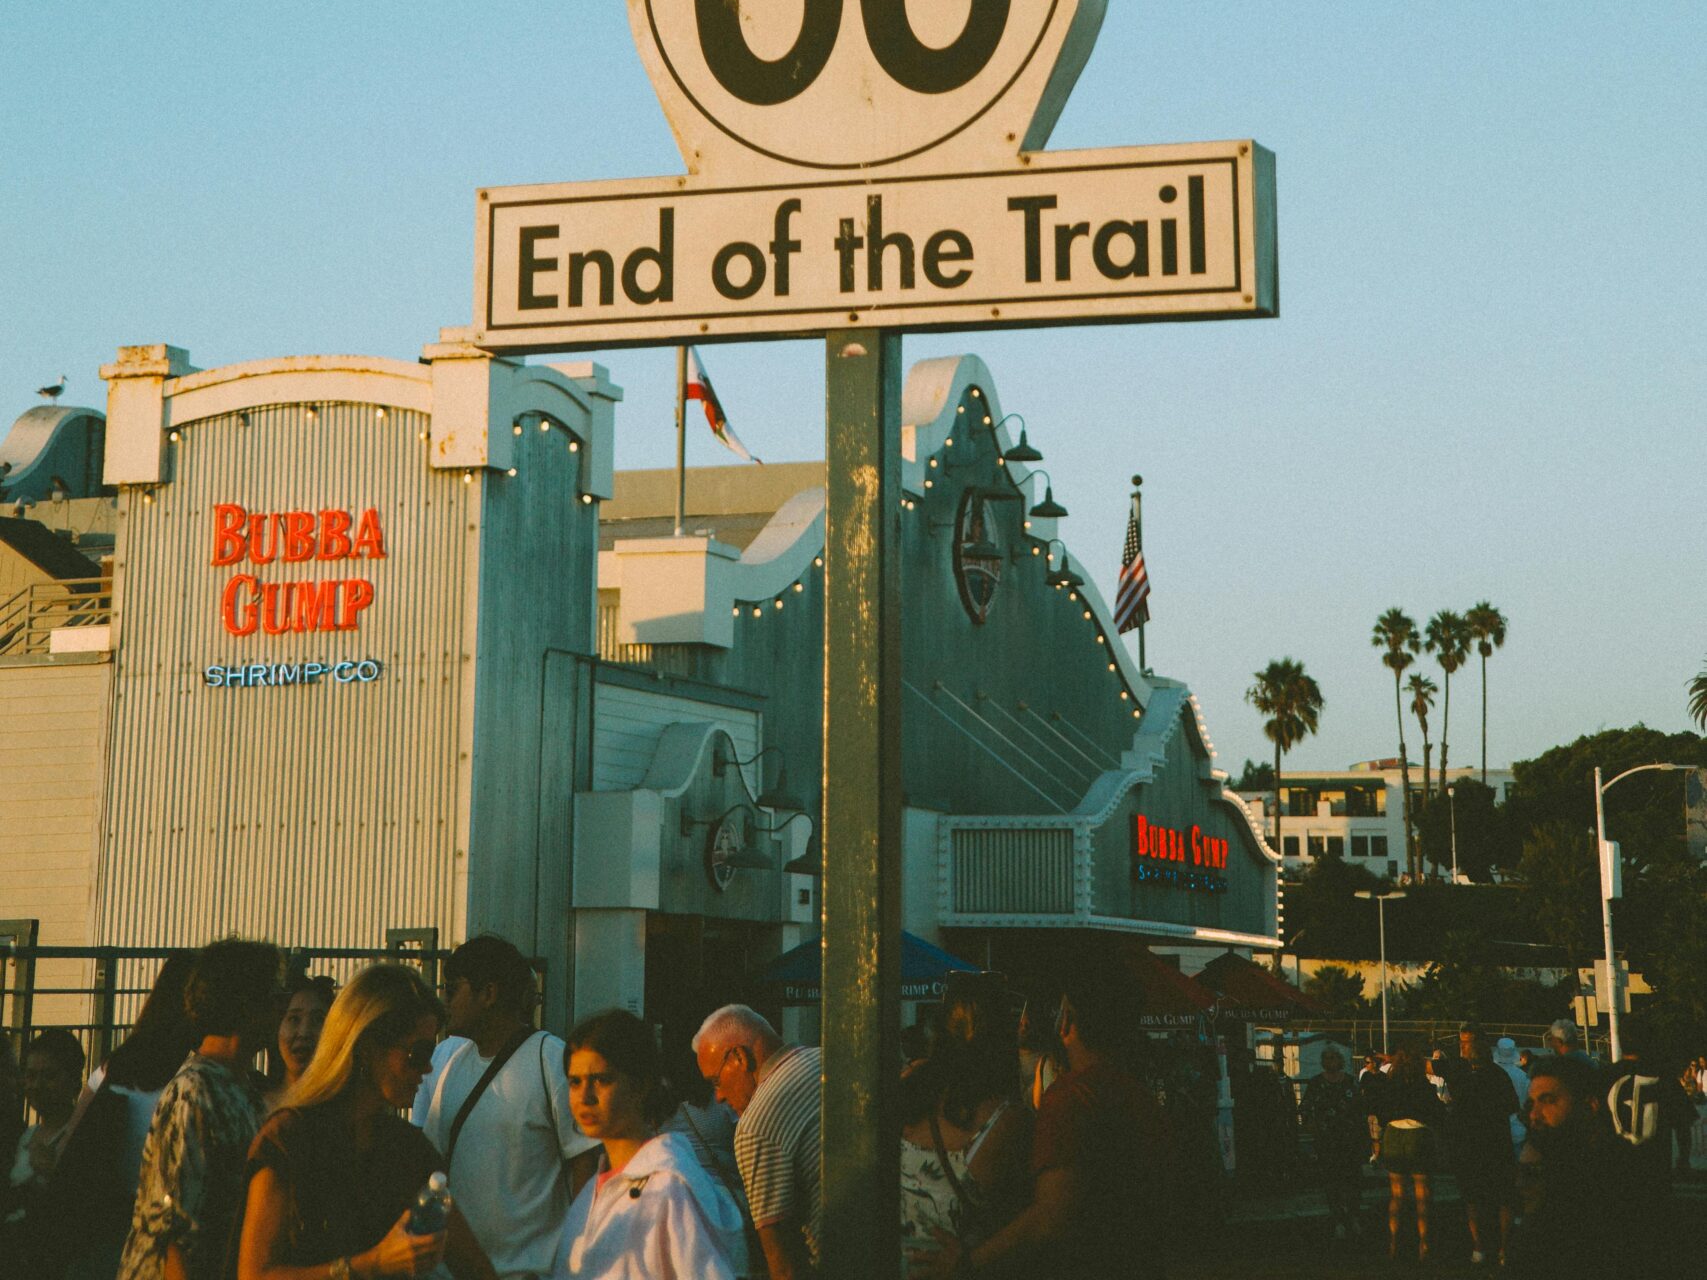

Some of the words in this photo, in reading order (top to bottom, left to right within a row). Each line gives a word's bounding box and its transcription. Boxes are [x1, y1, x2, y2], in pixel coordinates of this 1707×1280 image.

[517, 207, 675, 310] End
[711, 197, 802, 300] of
[834, 193, 974, 293] the
[1007, 174, 1207, 283] Trail
[211, 503, 386, 566] BUBBA
[221, 573, 374, 636] GUMP
[205, 662, 323, 687] SHRIMP
[1136, 813, 1185, 863] BUBBA
[1191, 824, 1228, 870] GUMP
[901, 984, 929, 996] RIMP
